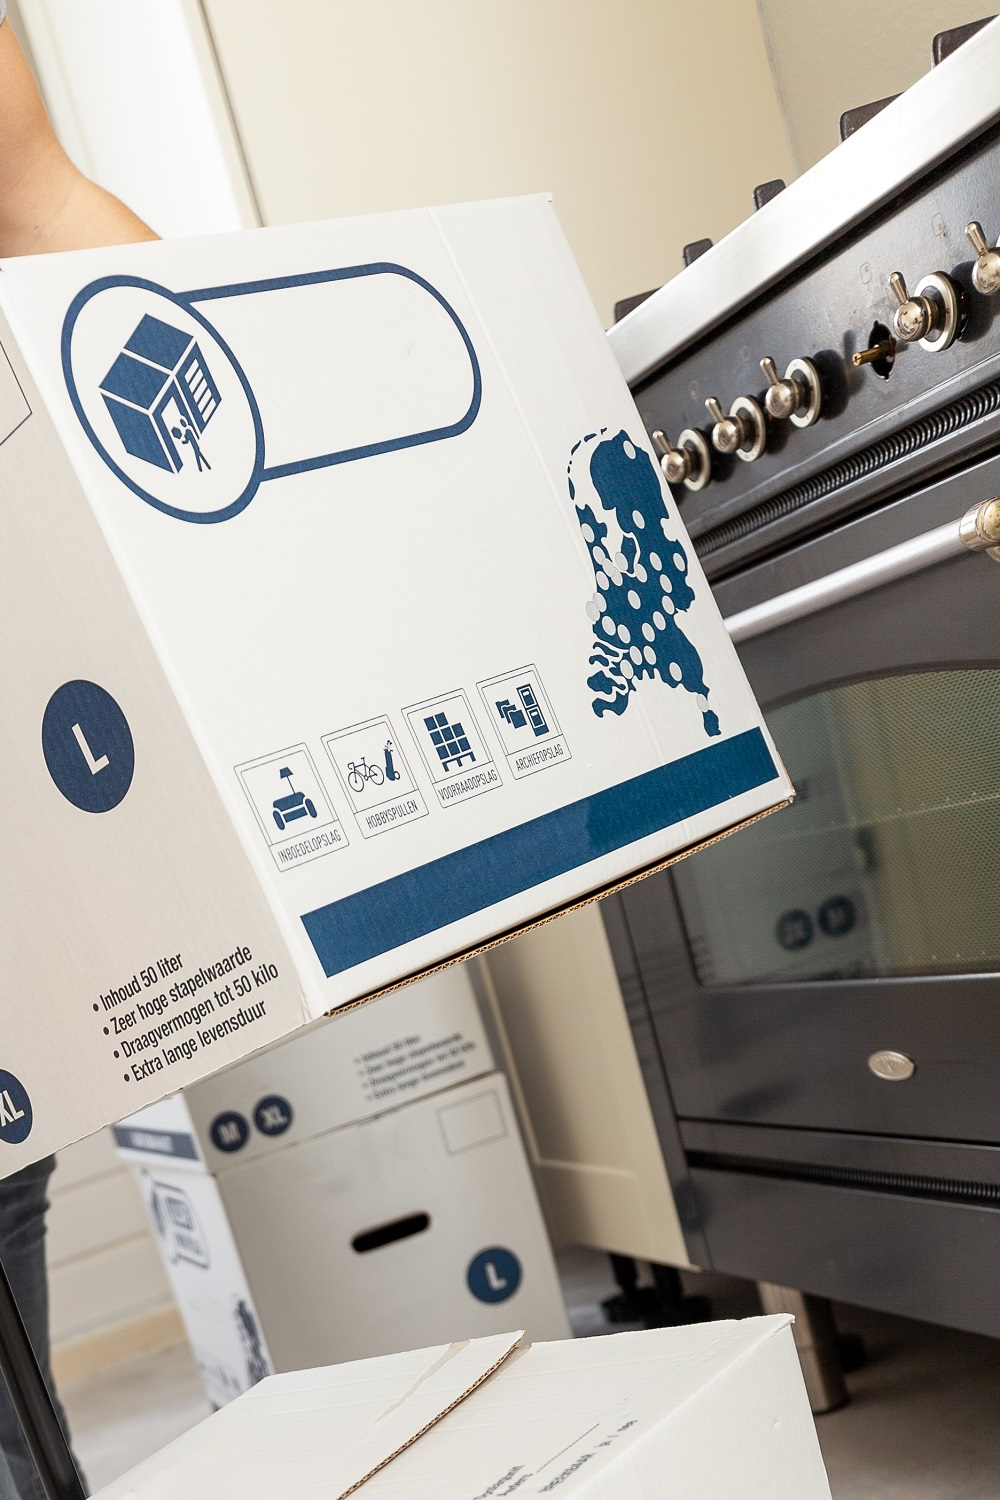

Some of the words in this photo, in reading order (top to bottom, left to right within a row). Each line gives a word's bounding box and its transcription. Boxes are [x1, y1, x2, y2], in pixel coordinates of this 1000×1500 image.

[71, 722, 110, 776] L
[515, 744, 564, 772] ARCHIEFOPSLAG
[437, 769, 498, 801] VOORRAADOPSLAG
[366, 799, 419, 830] HOBBYSPULLEN
[277, 829, 342, 863] INBOEDELOPSLAG
[99, 979, 142, 1012] Inhoud
[140, 966, 159, 988] 50
[157, 952, 184, 980] liter
[109, 1009, 138, 1036] Zeer
[136, 991, 170, 1020] hoge
[169, 944, 253, 1003] stapelwaarde
[120, 994, 215, 1059] Draagvermogen
[213, 987, 235, 1011] tot
[233, 975, 252, 998] 50
[251, 962, 279, 991] kilo
[130, 1053, 164, 1083] Extra
[162, 1036, 198, 1068] lange
[197, 998, 268, 1046] levensduur
[484, 1261, 509, 1292] L
